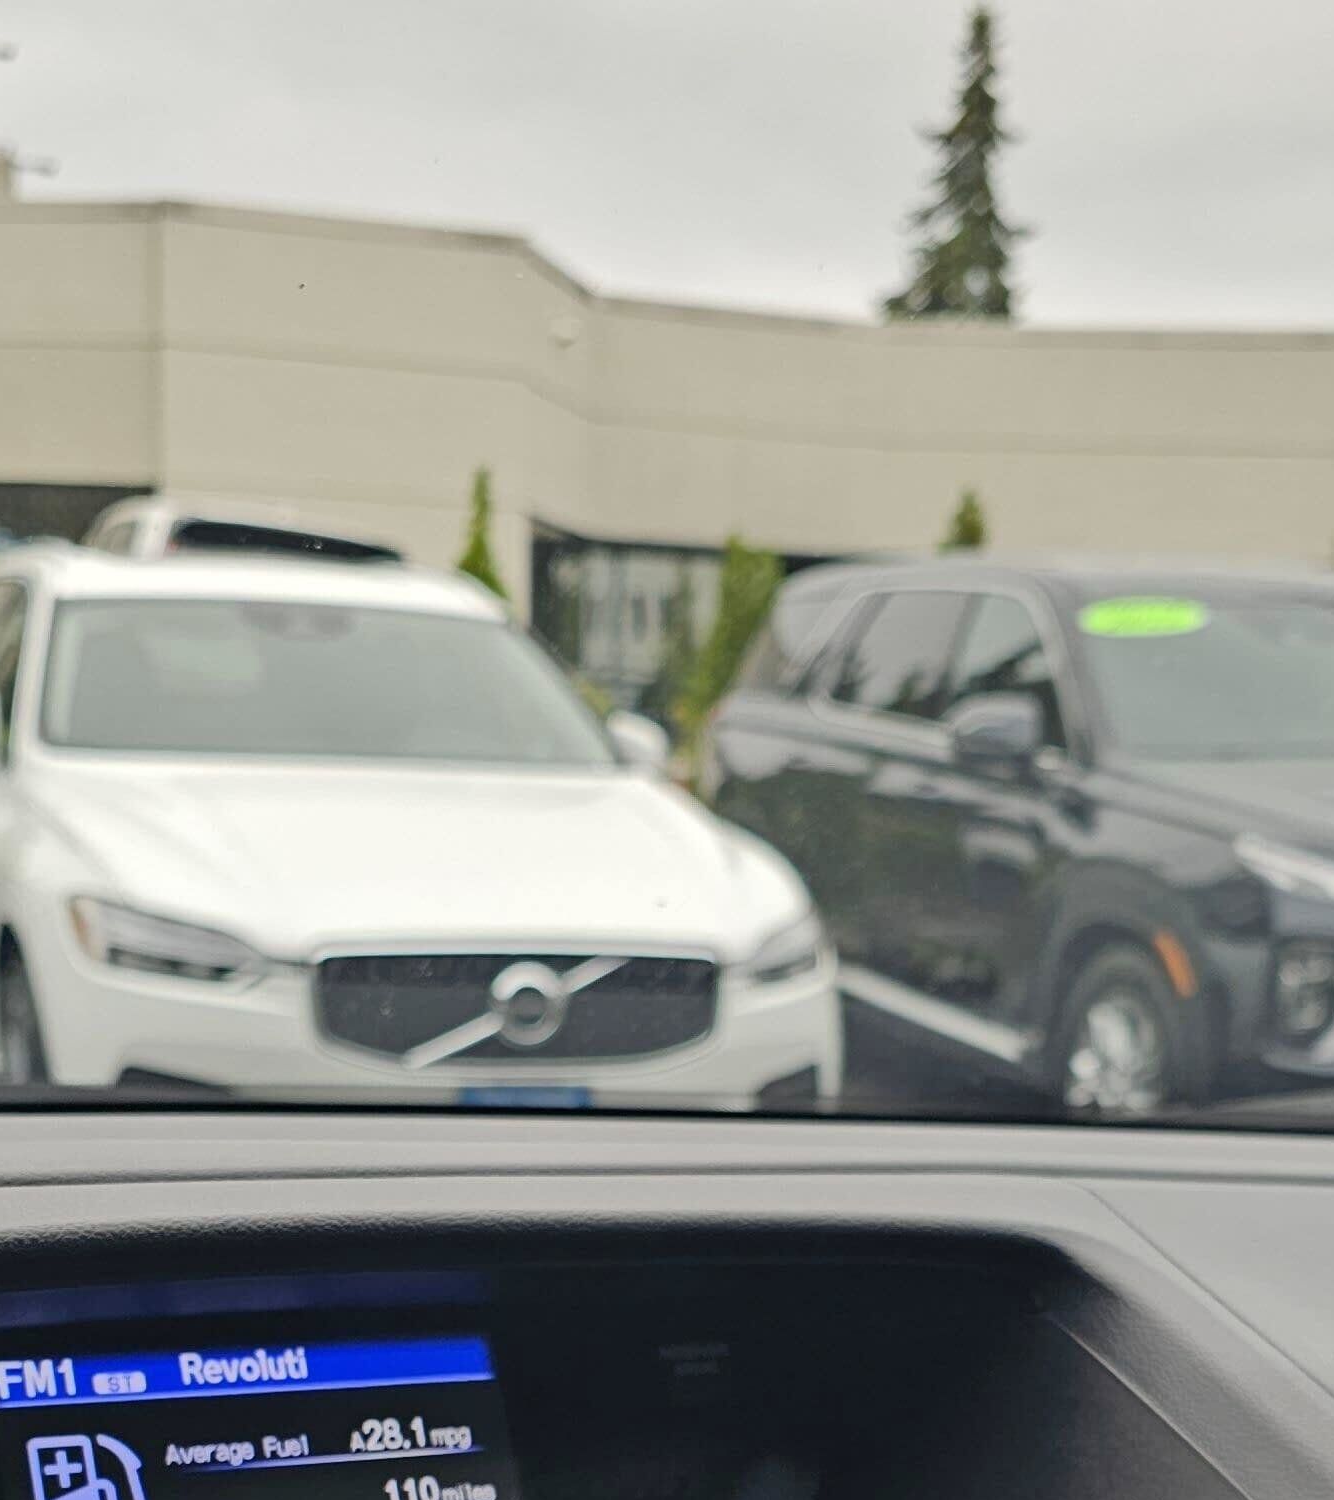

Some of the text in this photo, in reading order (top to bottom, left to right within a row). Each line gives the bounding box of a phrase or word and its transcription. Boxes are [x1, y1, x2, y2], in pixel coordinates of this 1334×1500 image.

[178, 1346, 309, 1386] Revoluti
[166, 1440, 255, 1467] Average
[262, 1434, 309, 1459] Fuel
